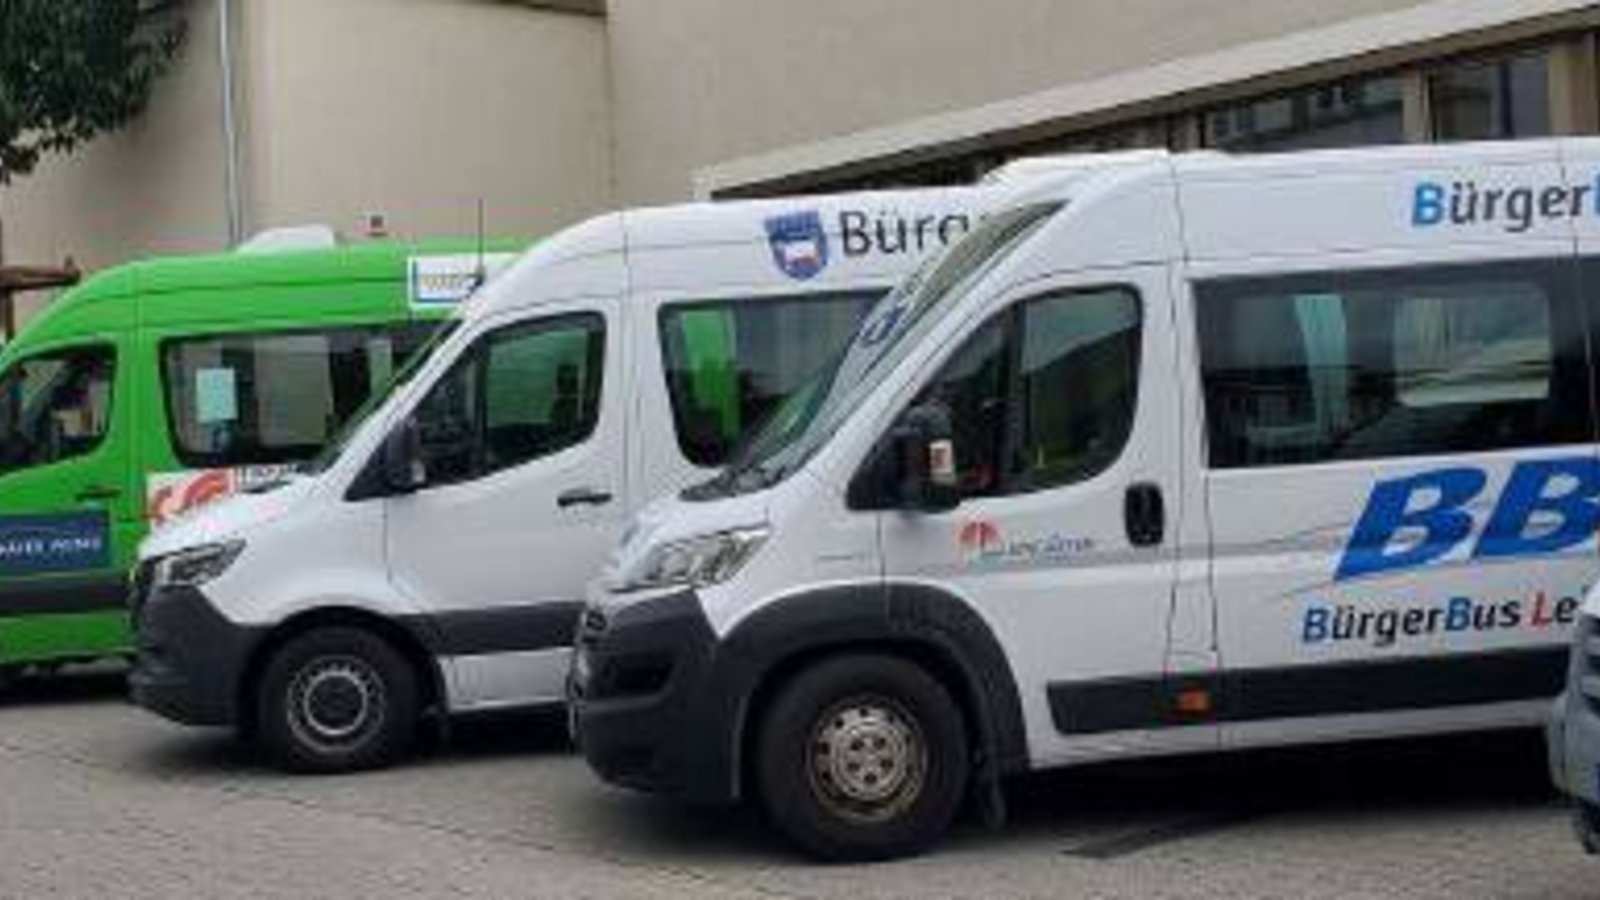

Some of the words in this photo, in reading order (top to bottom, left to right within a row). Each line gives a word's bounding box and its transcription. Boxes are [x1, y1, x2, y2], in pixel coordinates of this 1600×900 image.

[1412, 180, 1600, 233] Bürger
[1333, 457, 1600, 580] BB
[1302, 596, 1521, 647] BürgerBus
[1531, 590, 1588, 627] Le
